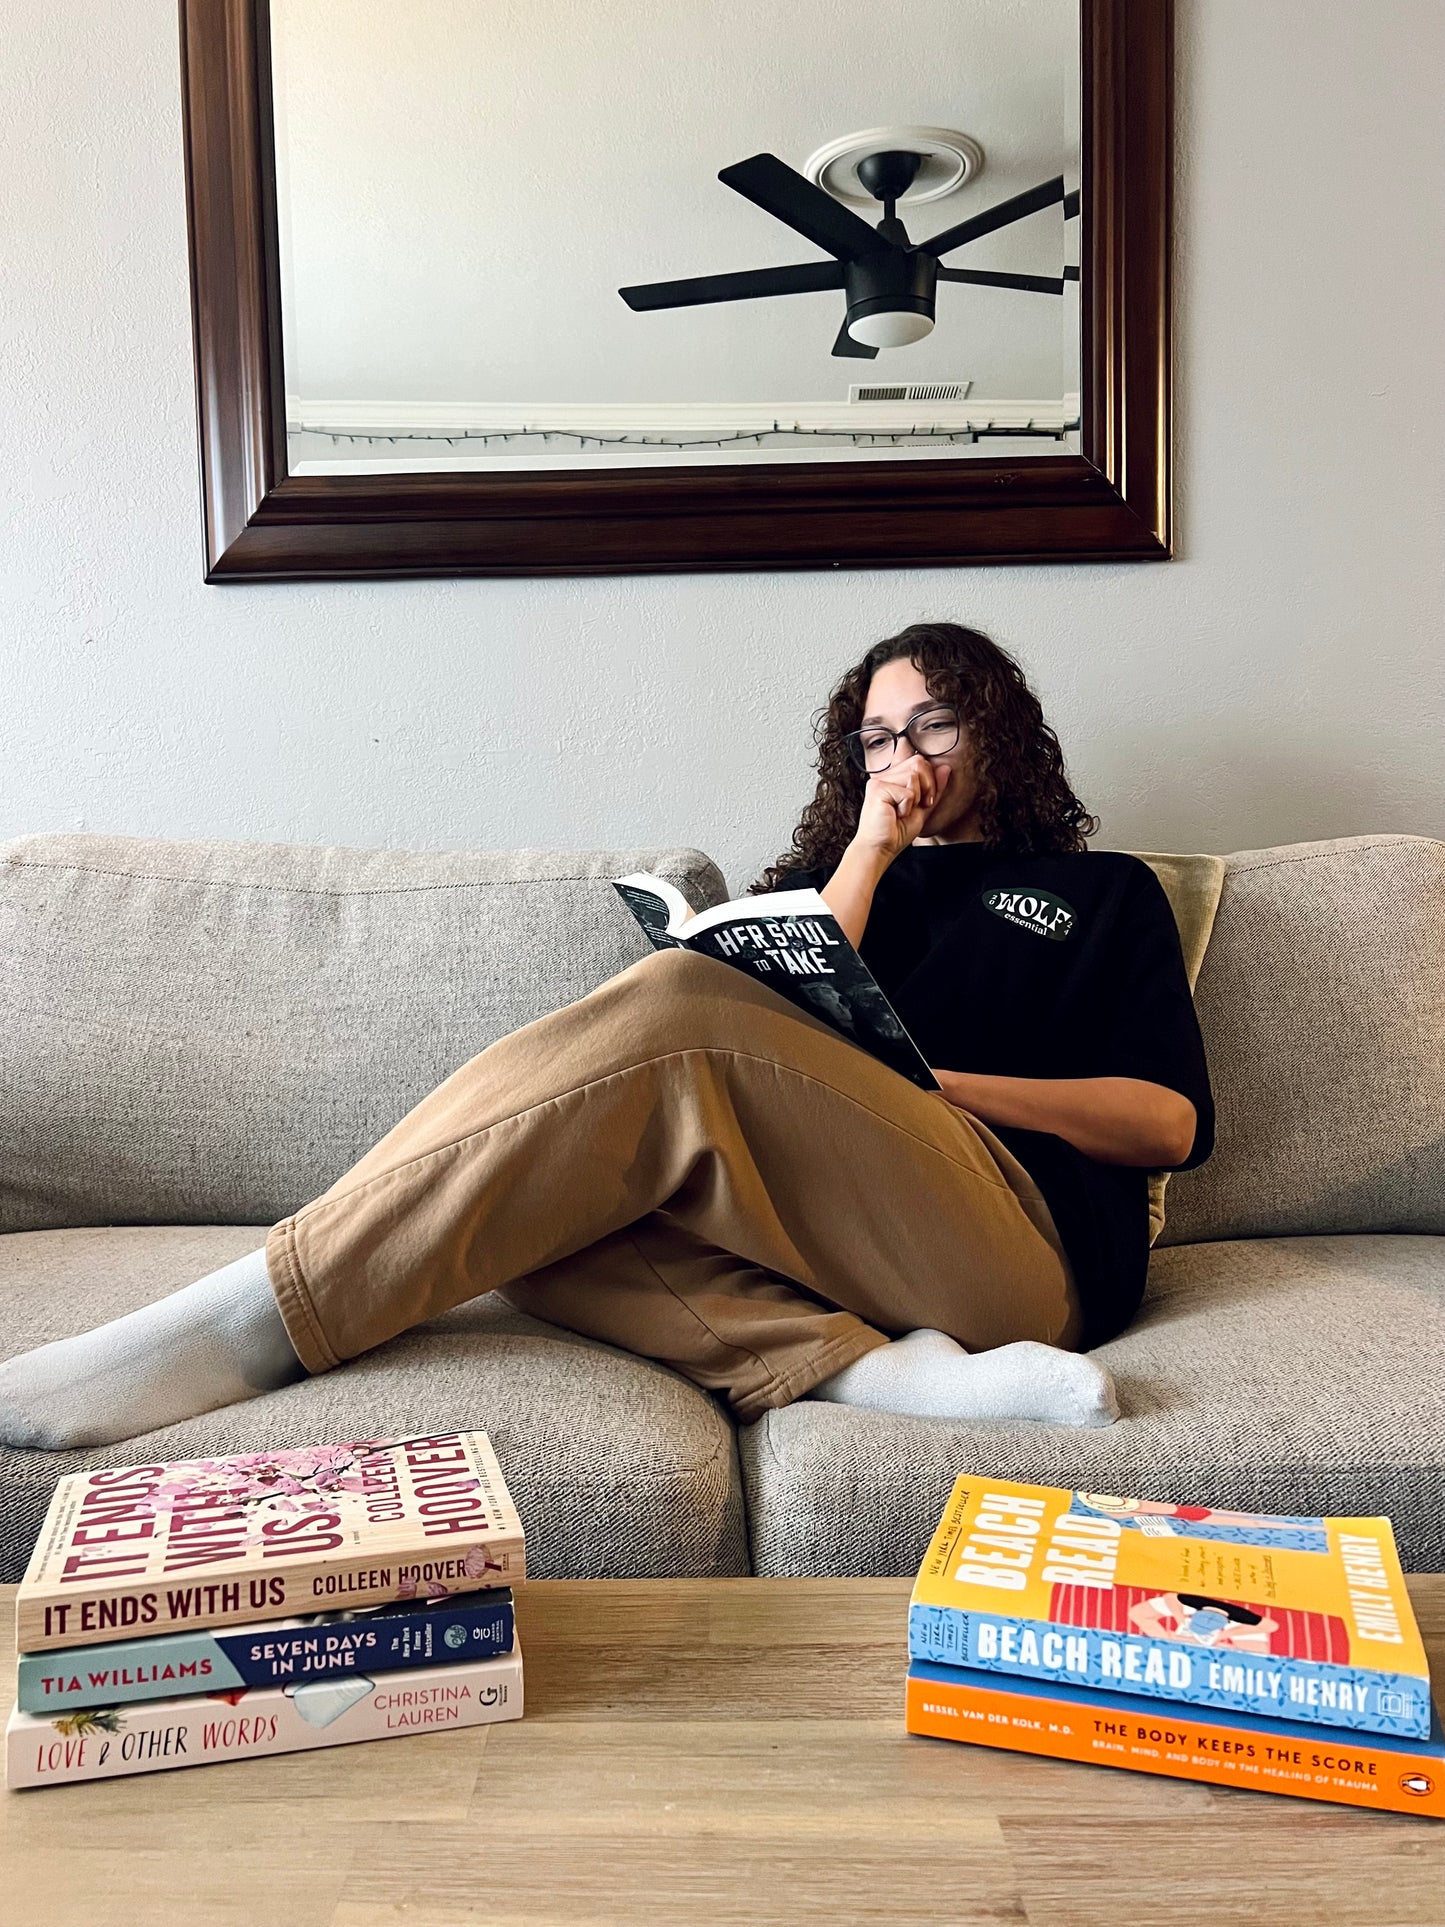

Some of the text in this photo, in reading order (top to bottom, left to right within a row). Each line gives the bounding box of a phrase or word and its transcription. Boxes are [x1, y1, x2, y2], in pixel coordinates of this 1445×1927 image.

[995, 892, 1072, 931] WOLF
[1004, 913, 1048, 936] essential
[714, 921, 840, 957] HER SOUL
[753, 947, 836, 975] TO TAKE
[361, 1458, 405, 1522] COLLEEN
[404, 1435, 489, 1537] HOOVER
[60, 1467, 166, 1583] IT ENDS
[163, 1487, 249, 1572] WITH
[262, 1514, 344, 1558] US
[929, 1489, 971, 1576] NEW YORK TIMES BESTSELLER
[954, 1493, 1046, 1591] BEACH
[1041, 1513, 1121, 1590] READ
[313, 1559, 467, 1596] COLLEEN HOOVER
[1338, 1532, 1404, 1644] EMILY HENRY
[44, 1576, 285, 1637] IT ENDS WITH US
[250, 1632, 377, 1661] SEVEN DAYS
[961, 1613, 969, 1662] BESTSELLER
[978, 1623, 1192, 1689] BEACH READ
[41, 1659, 213, 1695] TIA WILLIAMS
[272, 1651, 356, 1675] IN JUNE
[1209, 1662, 1282, 1699] EMILY
[1290, 1676, 1369, 1713] HENRY
[374, 1685, 471, 1710] CHRISTINA
[387, 1706, 459, 1729] LAUREN
[923, 1703, 959, 1718] BESSEL
[963, 1710, 985, 1721] VAN
[988, 1714, 1009, 1725] DER
[1049, 1724, 1075, 1736] M.D.
[37, 1714, 279, 1773] LOVE & OTHER WORDS
[1094, 1721, 1377, 1775] THE BODY KEEPS THE SCORE
[1165, 1752, 1189, 1763] AND
[1192, 1756, 1220, 1767] BODY
[1224, 1761, 1236, 1770] IN
[1240, 1763, 1259, 1774] THE
[1263, 1768, 1311, 1782] HEALING
[1315, 1774, 1329, 1784] OF
[1332, 1777, 1378, 1791] TRAUMA
